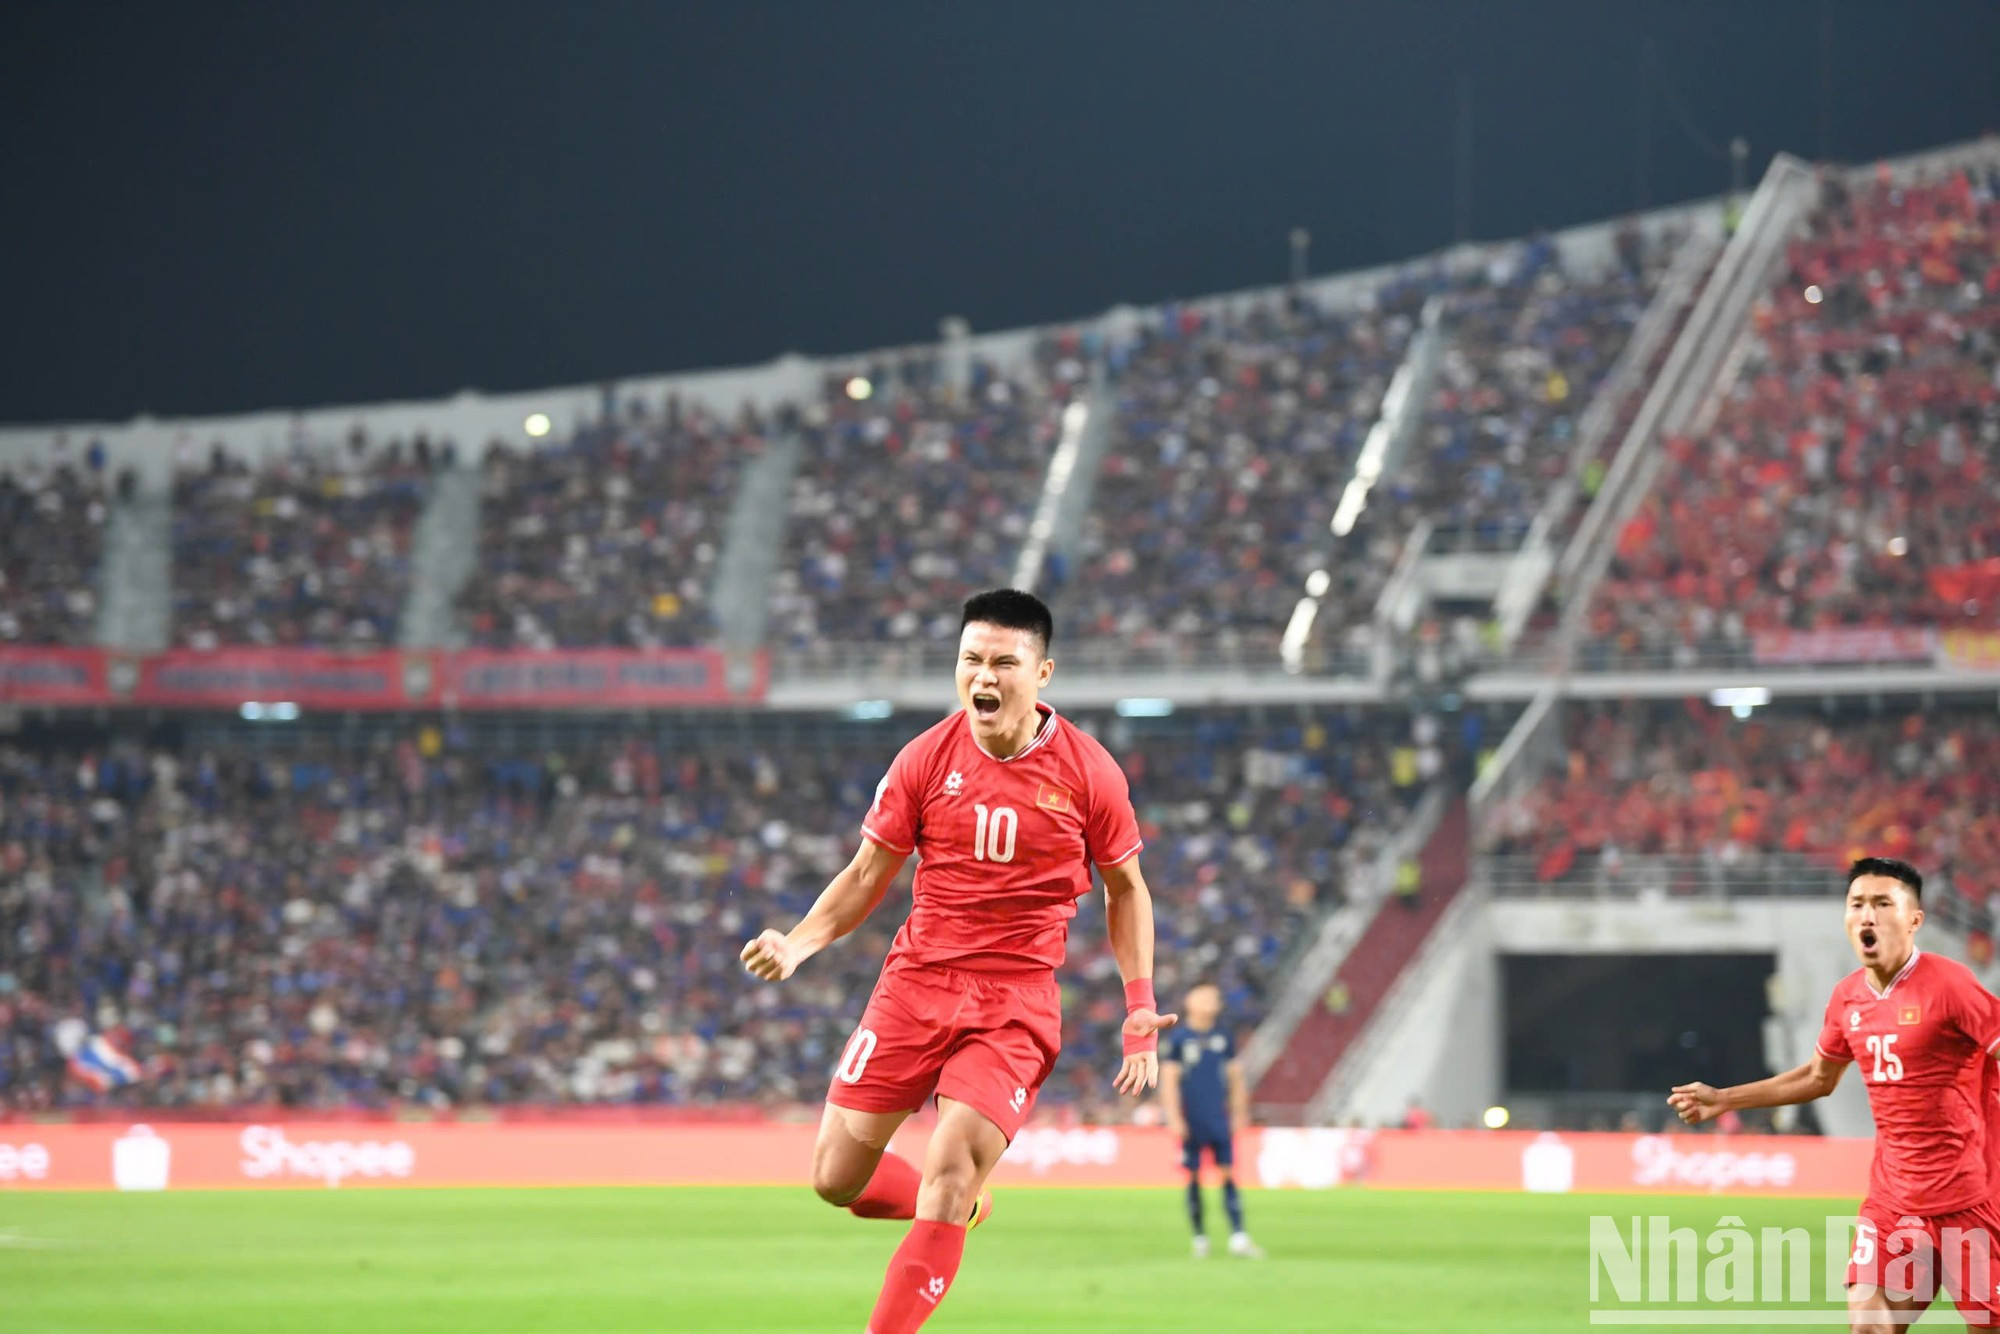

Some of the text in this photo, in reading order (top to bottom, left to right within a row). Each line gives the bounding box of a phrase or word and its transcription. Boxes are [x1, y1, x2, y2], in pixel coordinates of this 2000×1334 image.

[974, 804, 1018, 863] 10
[835, 1027, 878, 1083] 0
[1866, 1033, 1904, 1082] 25
[240, 1124, 412, 1187] Shopee
[1633, 1135, 1794, 1192] Shopee
[1848, 1224, 1878, 1266] 5
